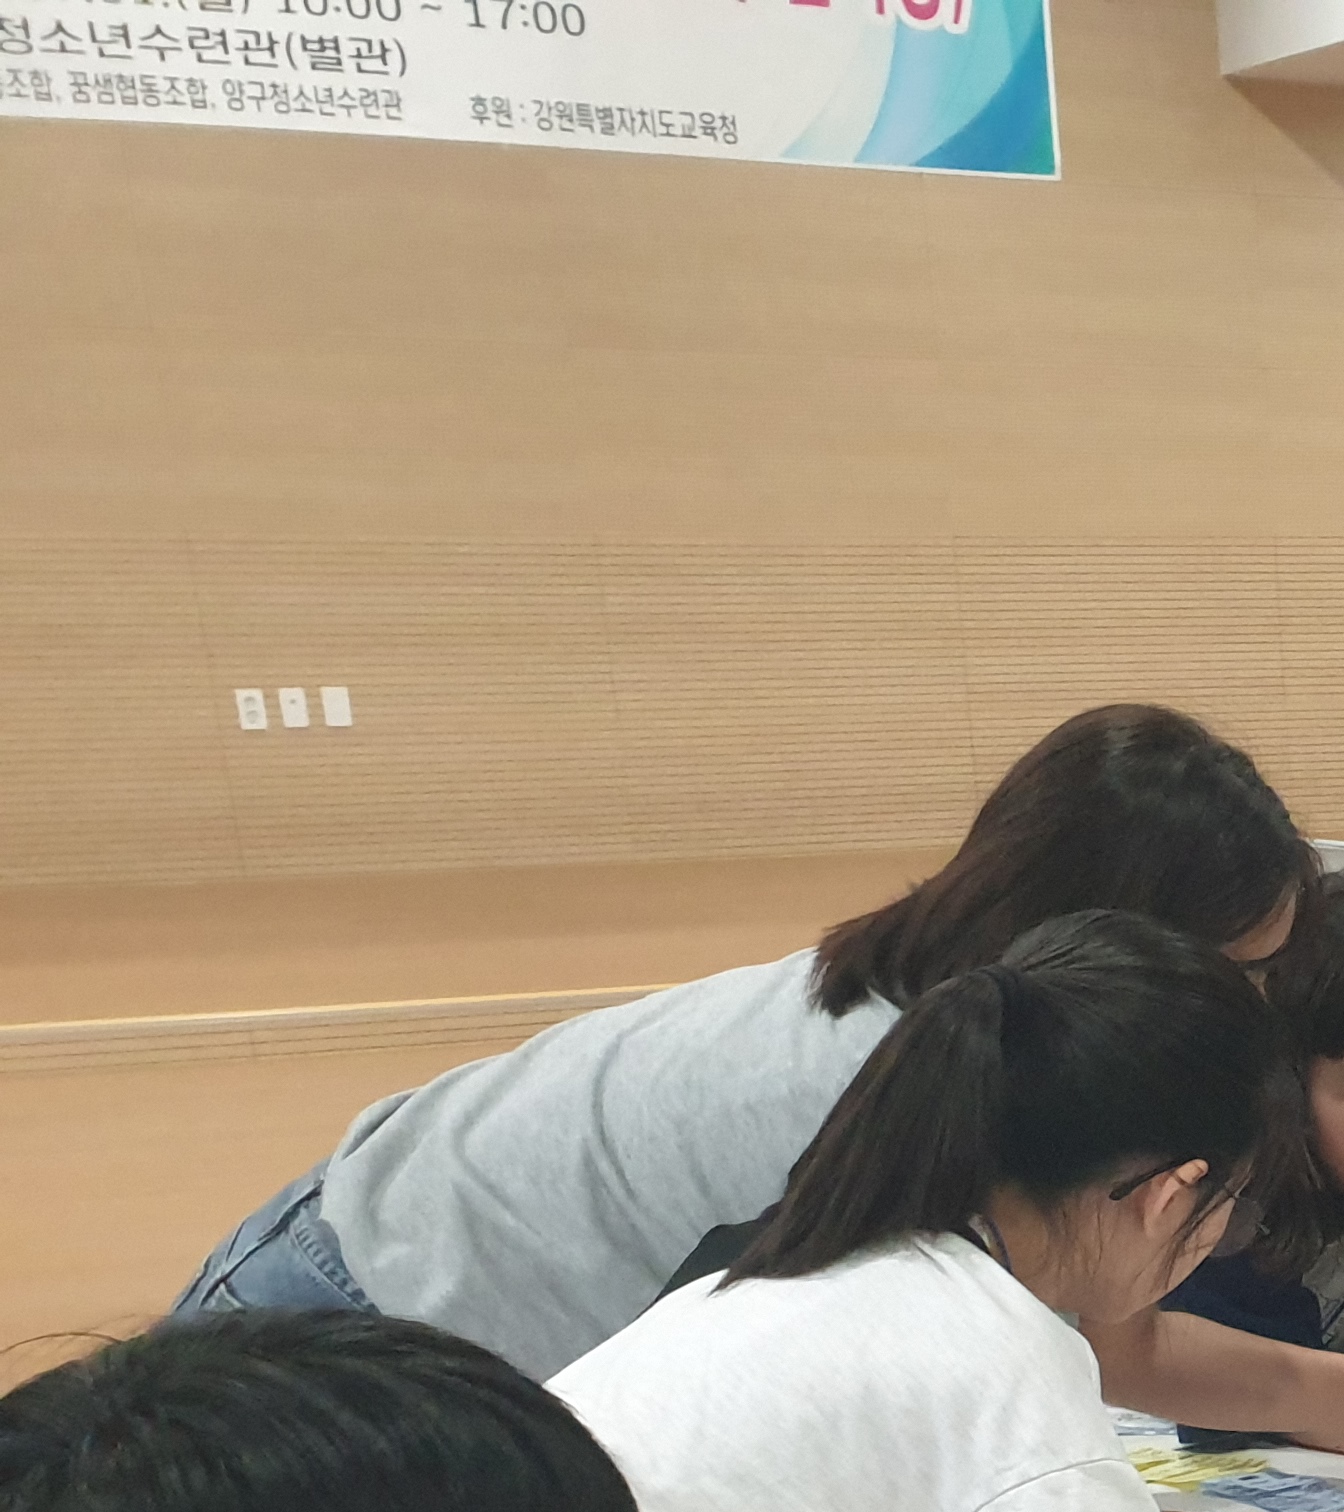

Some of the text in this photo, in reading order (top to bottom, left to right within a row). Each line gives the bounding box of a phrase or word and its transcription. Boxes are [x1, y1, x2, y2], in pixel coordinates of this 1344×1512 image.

[0, 68, 62, 103] 조합,
[221, 79, 404, 121] 양구청소년수련관
[530, 98, 741, 146] 강원특별자치도교육청
